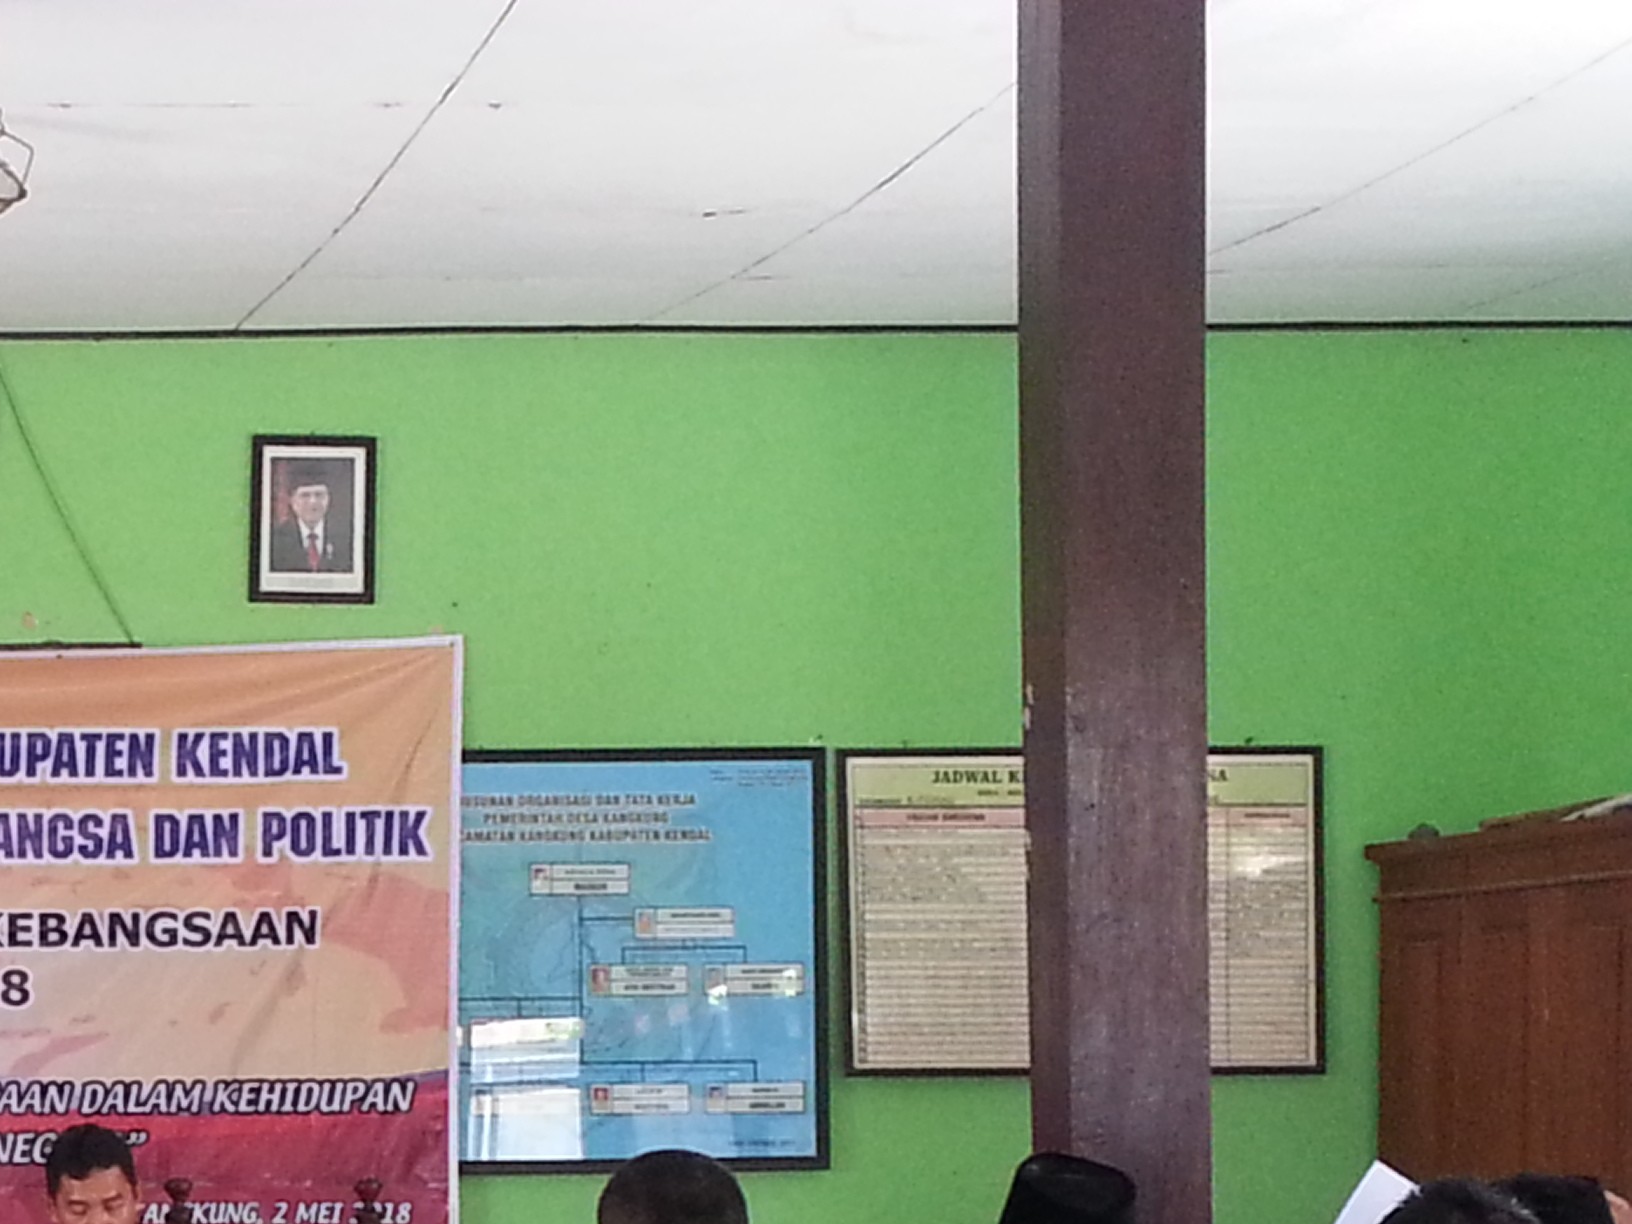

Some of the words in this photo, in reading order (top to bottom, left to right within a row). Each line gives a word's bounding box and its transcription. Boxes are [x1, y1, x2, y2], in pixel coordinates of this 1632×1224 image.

[175, 732, 344, 778] KENDAL
[932, 770, 1003, 784] JADWAL
[154, 812, 240, 860] DAN
[261, 809, 429, 859] POLITIK
[76, 1082, 204, 1114] DALAM
[213, 1081, 416, 1113] KEHIDUPAN
[271, 1203, 287, 1224] 2
[294, 1203, 342, 1224] MEI
